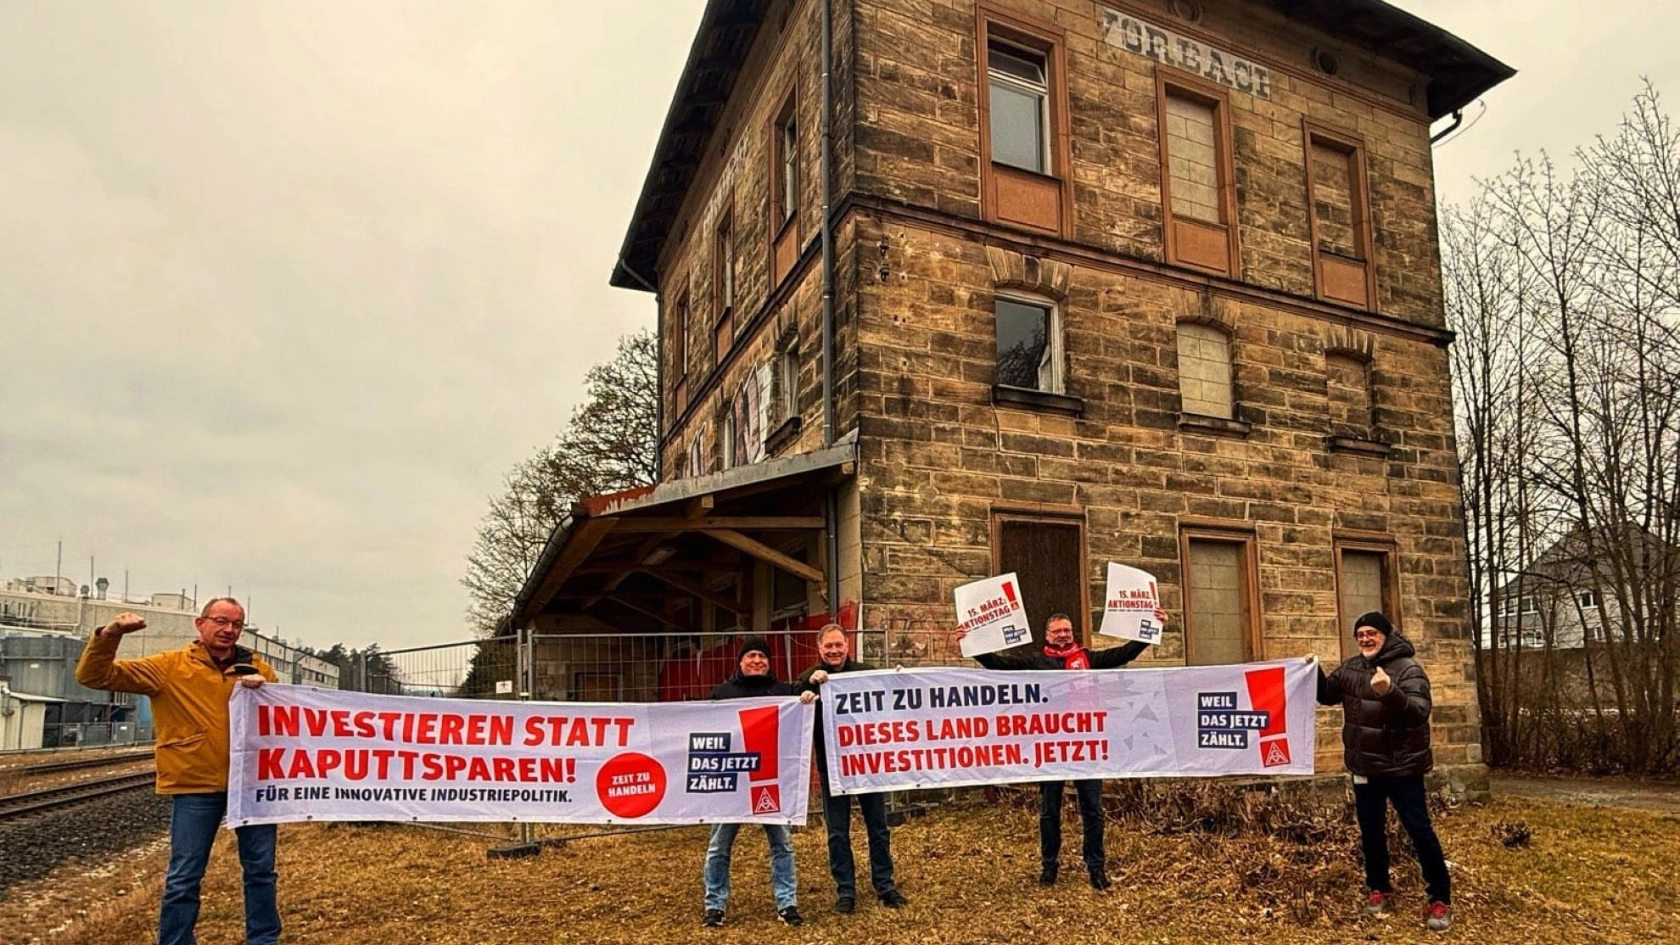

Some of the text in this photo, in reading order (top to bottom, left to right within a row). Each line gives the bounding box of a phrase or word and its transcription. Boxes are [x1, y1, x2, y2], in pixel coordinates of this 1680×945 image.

[1107, 600, 1154, 609] AKTIONSTAG
[835, 683, 1049, 715] ZEIT ZU HANDELN.
[1201, 696, 1233, 707] WEIL
[257, 705, 635, 747] INVESTIEREN STATT
[838, 712, 1108, 747] DIESES LAND BRAUCHT
[1201, 714, 1268, 729] DAS JETZT
[692, 737, 726, 750] WEIL
[1201, 731, 1245, 746] ZÄHLT.
[257, 747, 577, 783] KAPUTTSPAREN!
[691, 756, 758, 772] DAS JETZT
[841, 740, 1108, 776] INVESTITIONEN. JETZT!
[611, 771, 651, 786] ZEIT ZU
[690, 775, 733, 791] ZÄHLT.
[256, 785, 573, 803] FÜR EINE INNOVATIVE INDUSTRIEPOLITIK.
[608, 784, 656, 797] HANDELN
